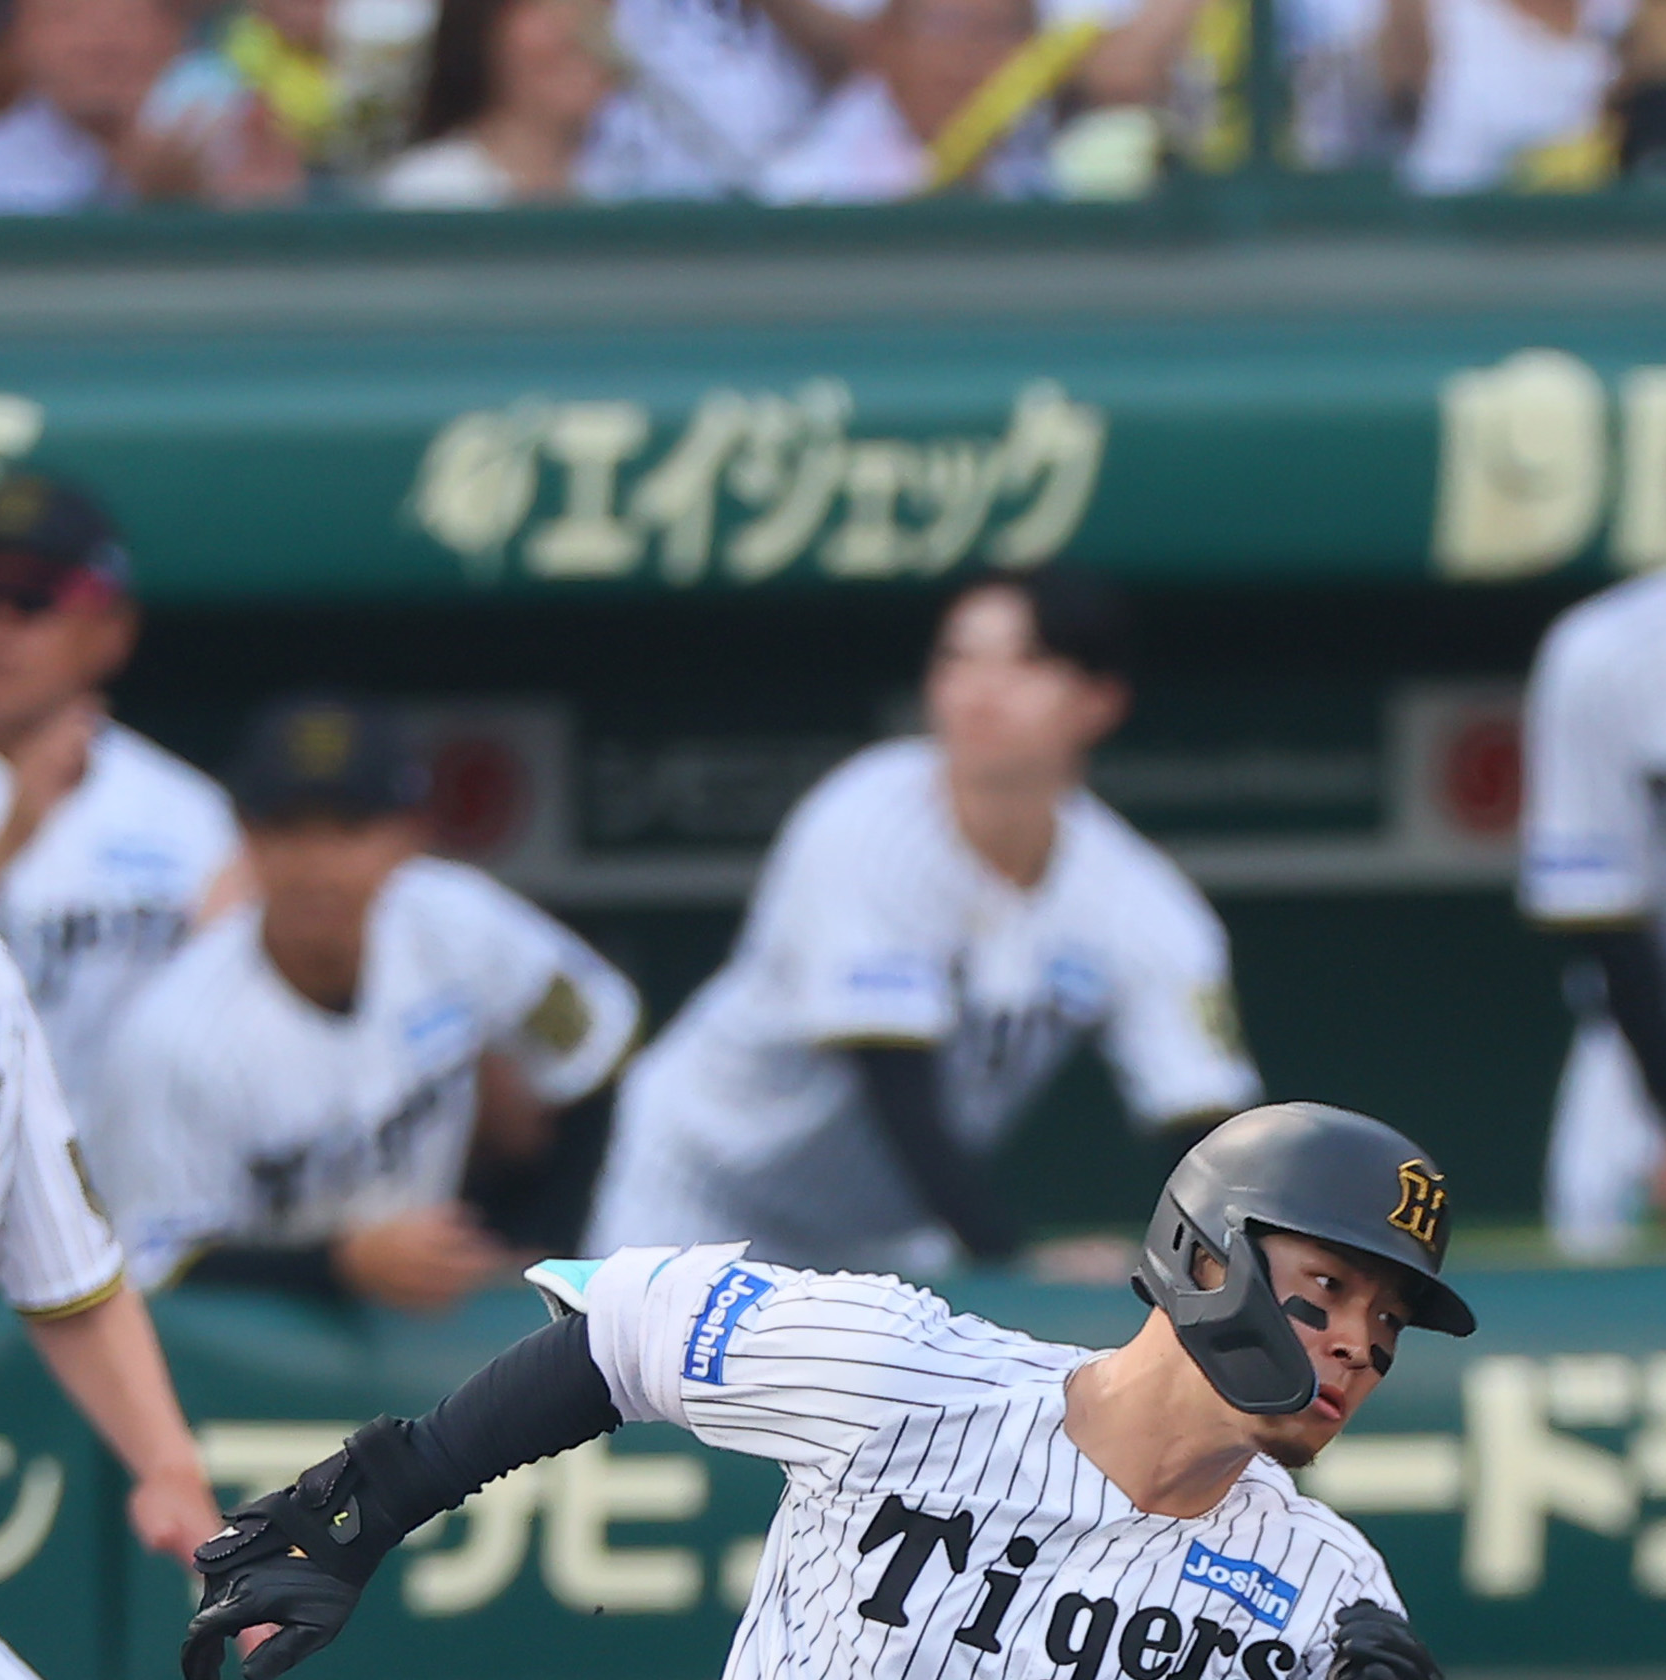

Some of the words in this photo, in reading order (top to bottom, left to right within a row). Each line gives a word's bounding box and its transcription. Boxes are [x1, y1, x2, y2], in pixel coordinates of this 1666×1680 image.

[520, 378, 1106, 585] エイジェック
[691, 1273, 754, 1377] Joshin
[1185, 1555, 1290, 1620] Joshin
